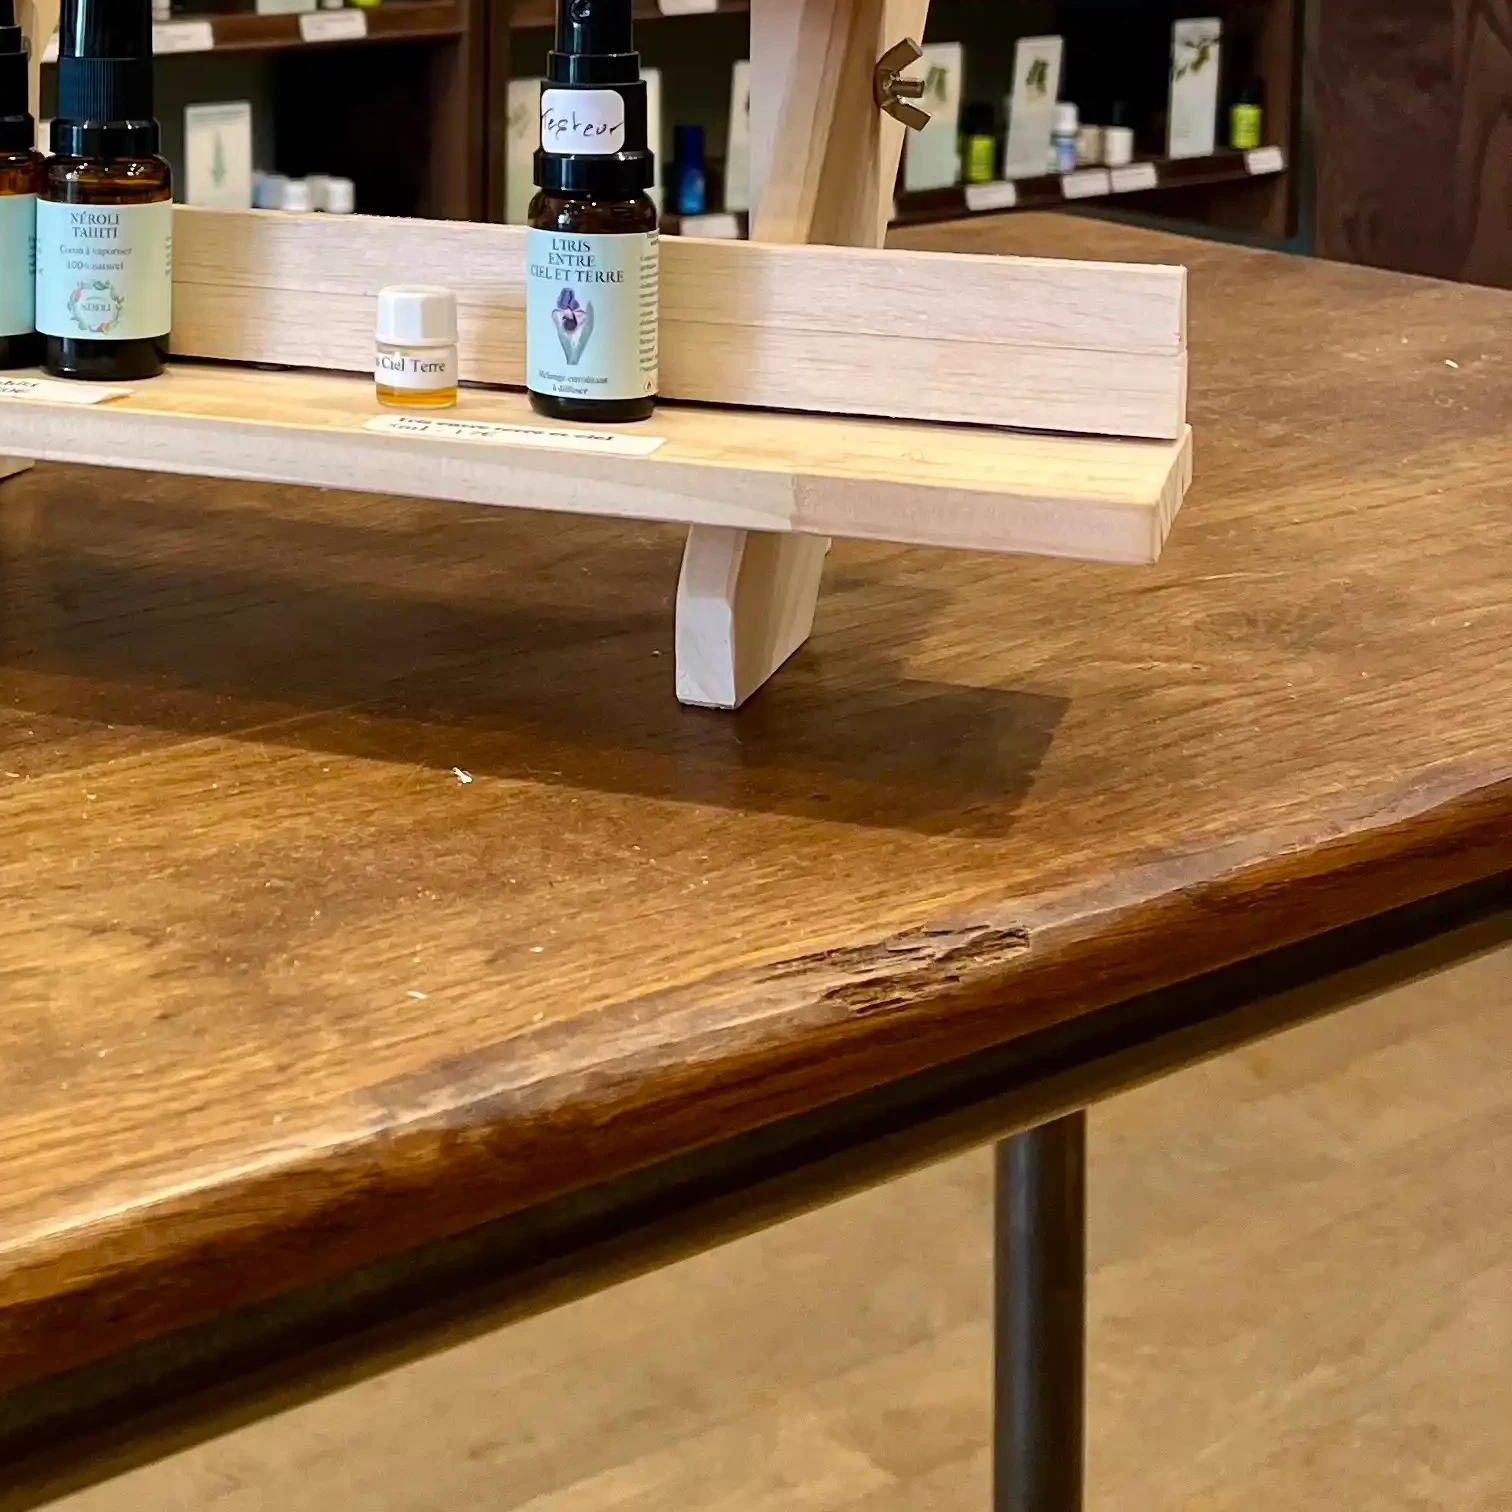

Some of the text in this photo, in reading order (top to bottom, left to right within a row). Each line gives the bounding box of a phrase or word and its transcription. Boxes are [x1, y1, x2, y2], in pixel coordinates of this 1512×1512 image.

[70, 210, 120, 226] NÉROLI
[71, 226, 119, 239] TAHITI
[548, 252, 596, 268] ENTRE
[530, 264, 625, 284] CIEL ET TERRE
[382, 356, 405, 372] Ciel
[410, 357, 446, 373] Terre
